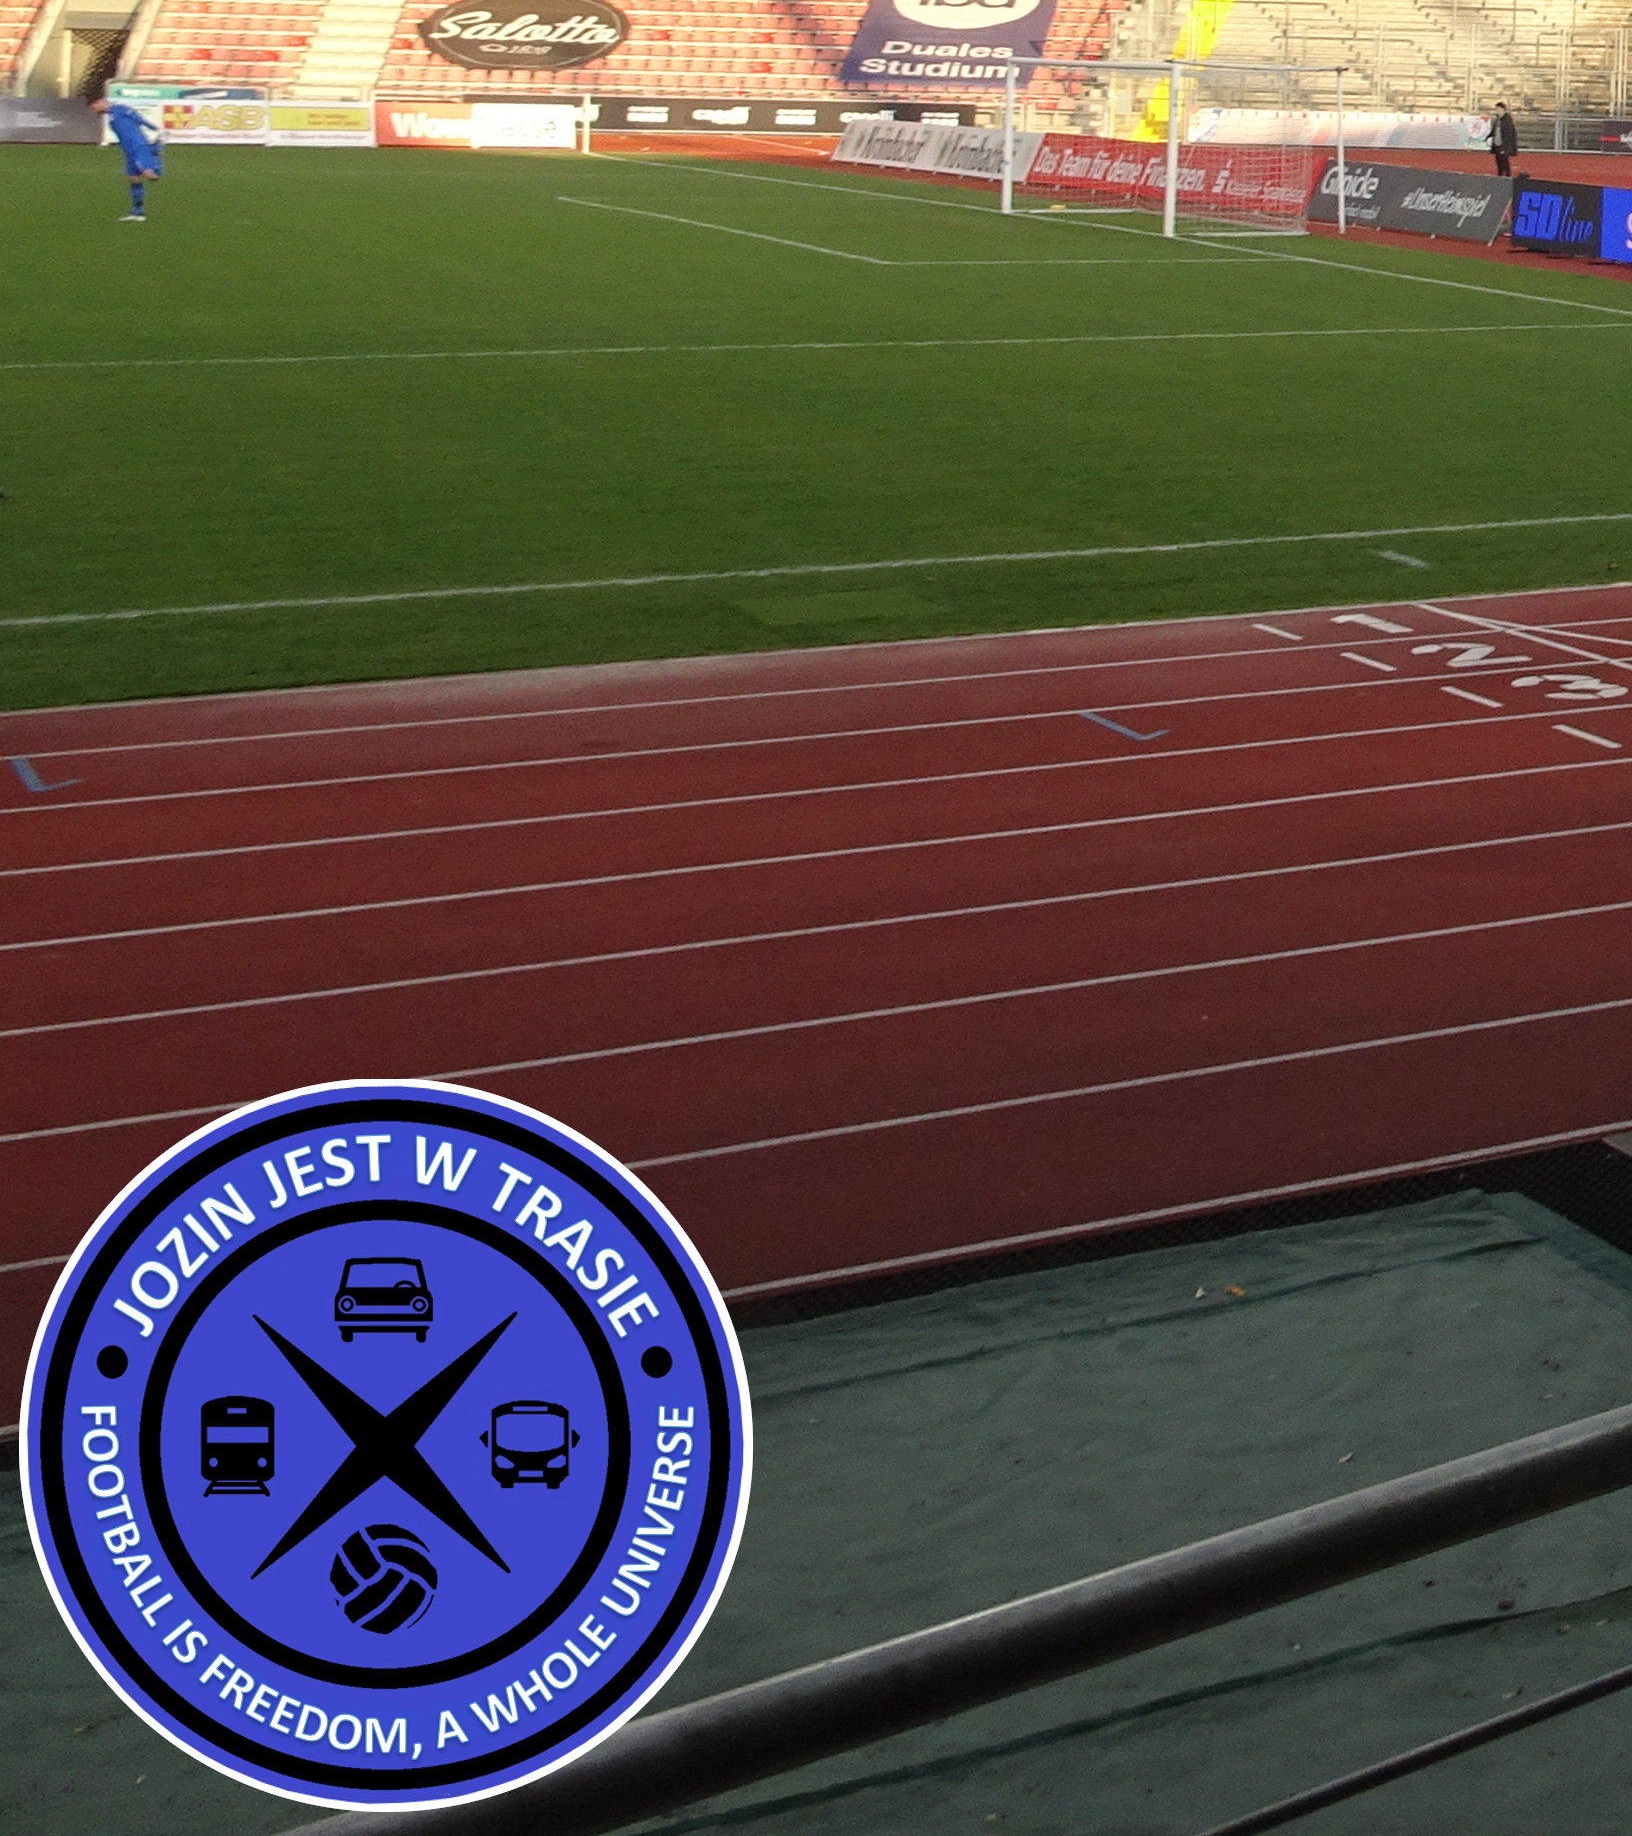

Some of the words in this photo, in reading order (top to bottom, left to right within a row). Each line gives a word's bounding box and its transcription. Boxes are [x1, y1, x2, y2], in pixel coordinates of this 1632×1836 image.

[429, 10, 620, 44] Salotto
[881, 40, 1014, 59] Duales
[860, 58, 1021, 79] Studium
[190, 105, 265, 131] ASB
[1033, 145, 1058, 174] Das
[1061, 148, 1091, 178] Team
[1410, 641, 1533, 667] 2
[1511, 673, 1628, 699] 3
